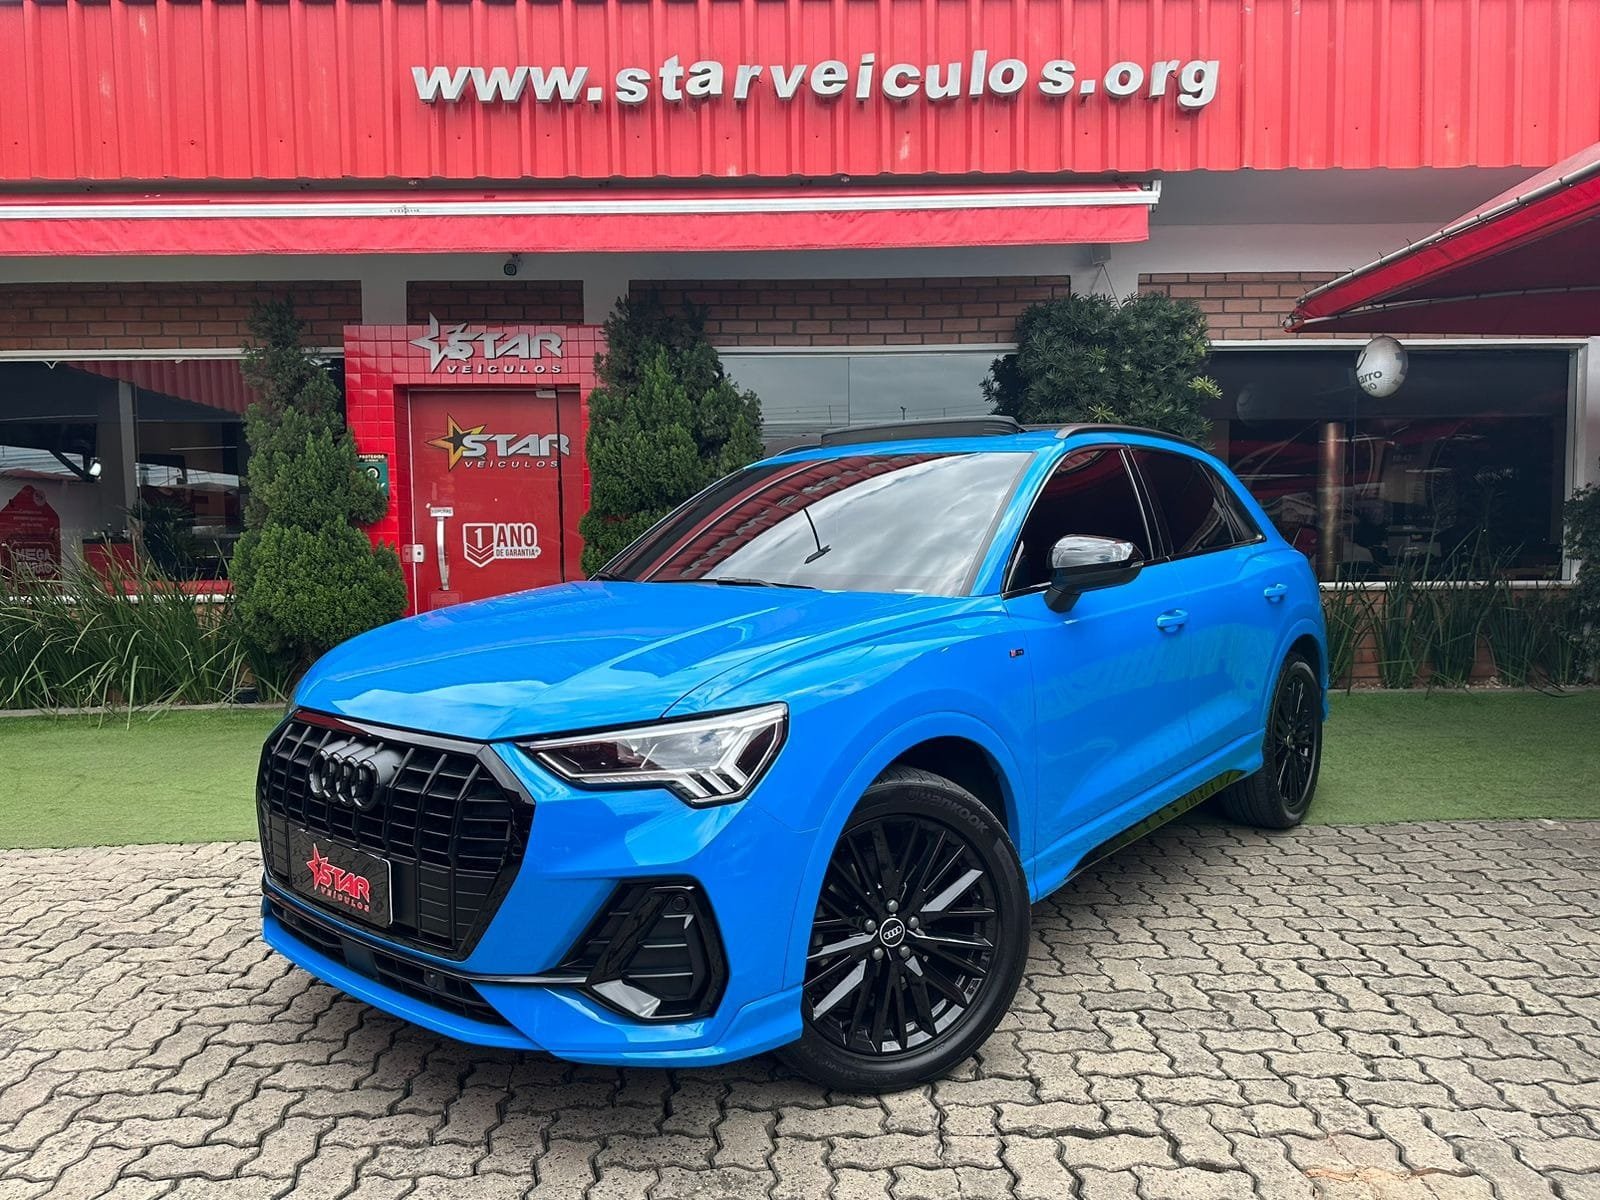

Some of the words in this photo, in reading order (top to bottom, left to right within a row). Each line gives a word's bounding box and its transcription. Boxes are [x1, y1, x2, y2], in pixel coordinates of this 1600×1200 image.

[411, 49, 1220, 110] www.starveiculos.org
[446, 331, 563, 361] STAR
[462, 434, 570, 457] STAR
[474, 527, 483, 549] 1
[496, 525, 535, 547] ANO
[496, 549, 504, 557] DE
[320, 862, 370, 903] STAR
